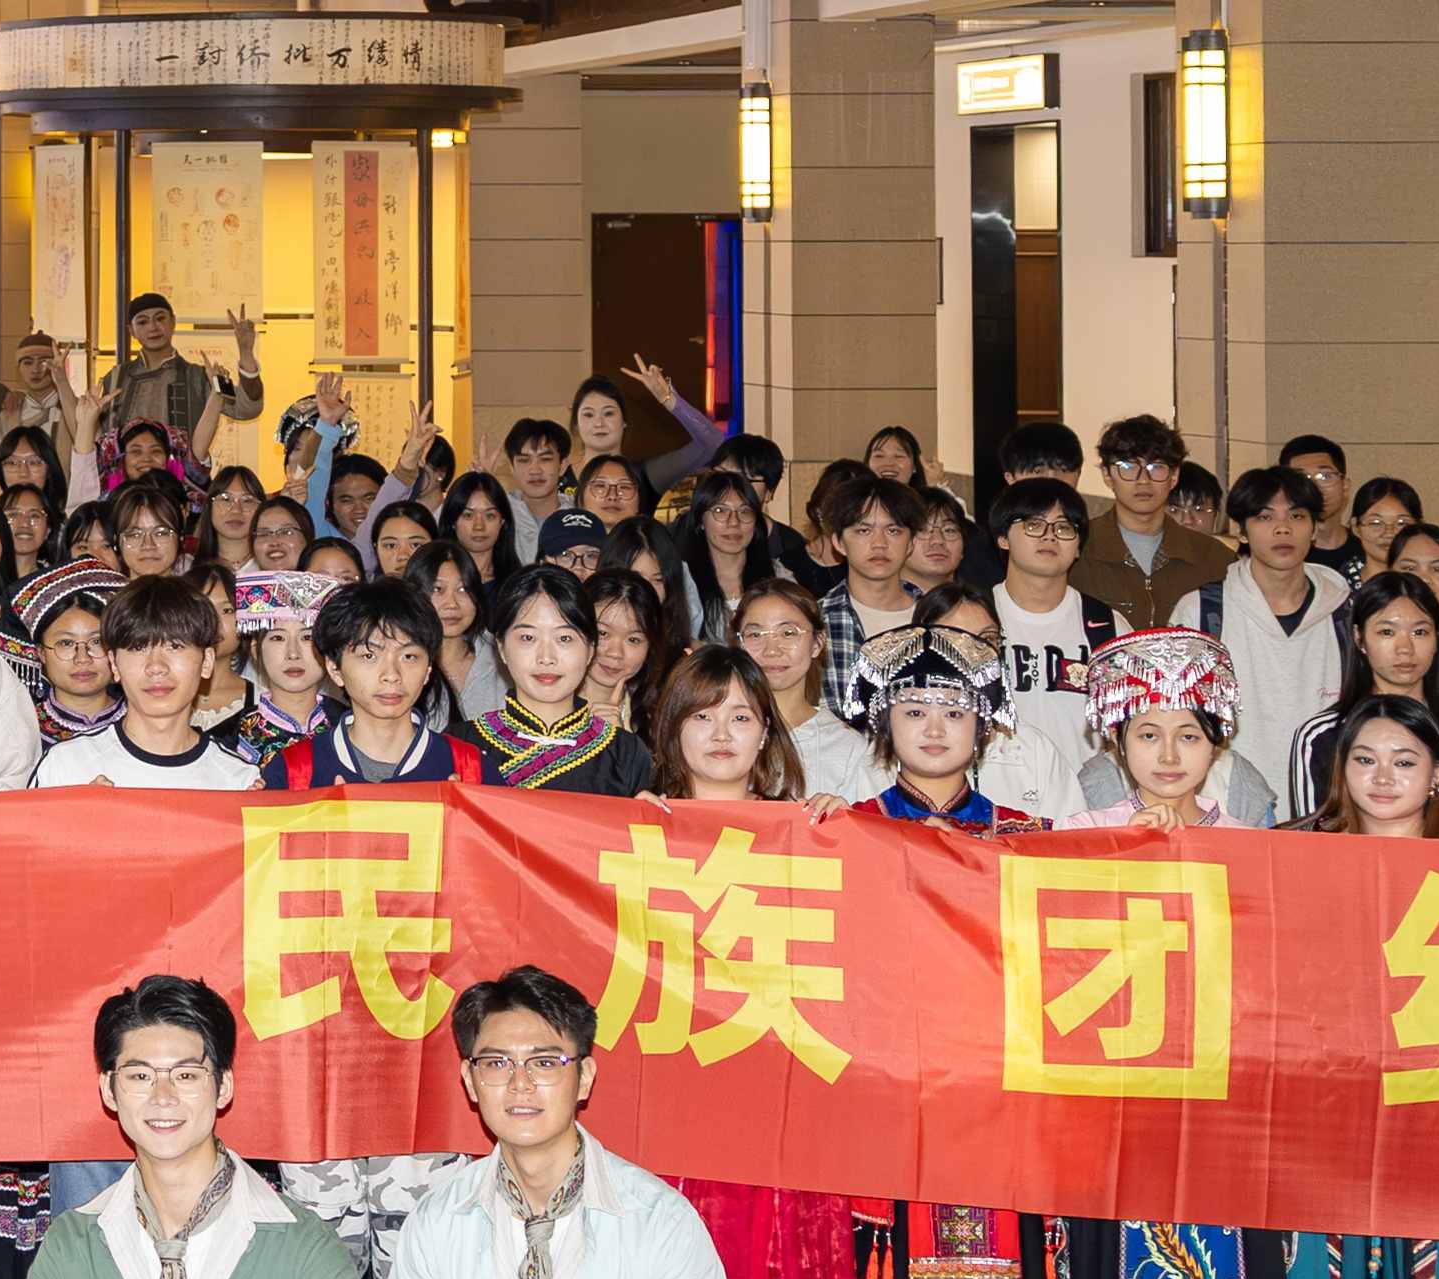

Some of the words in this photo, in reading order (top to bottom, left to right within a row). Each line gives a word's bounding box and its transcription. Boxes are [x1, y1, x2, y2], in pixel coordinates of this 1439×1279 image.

[155, 40, 424, 73] 一封侨批万缕情
